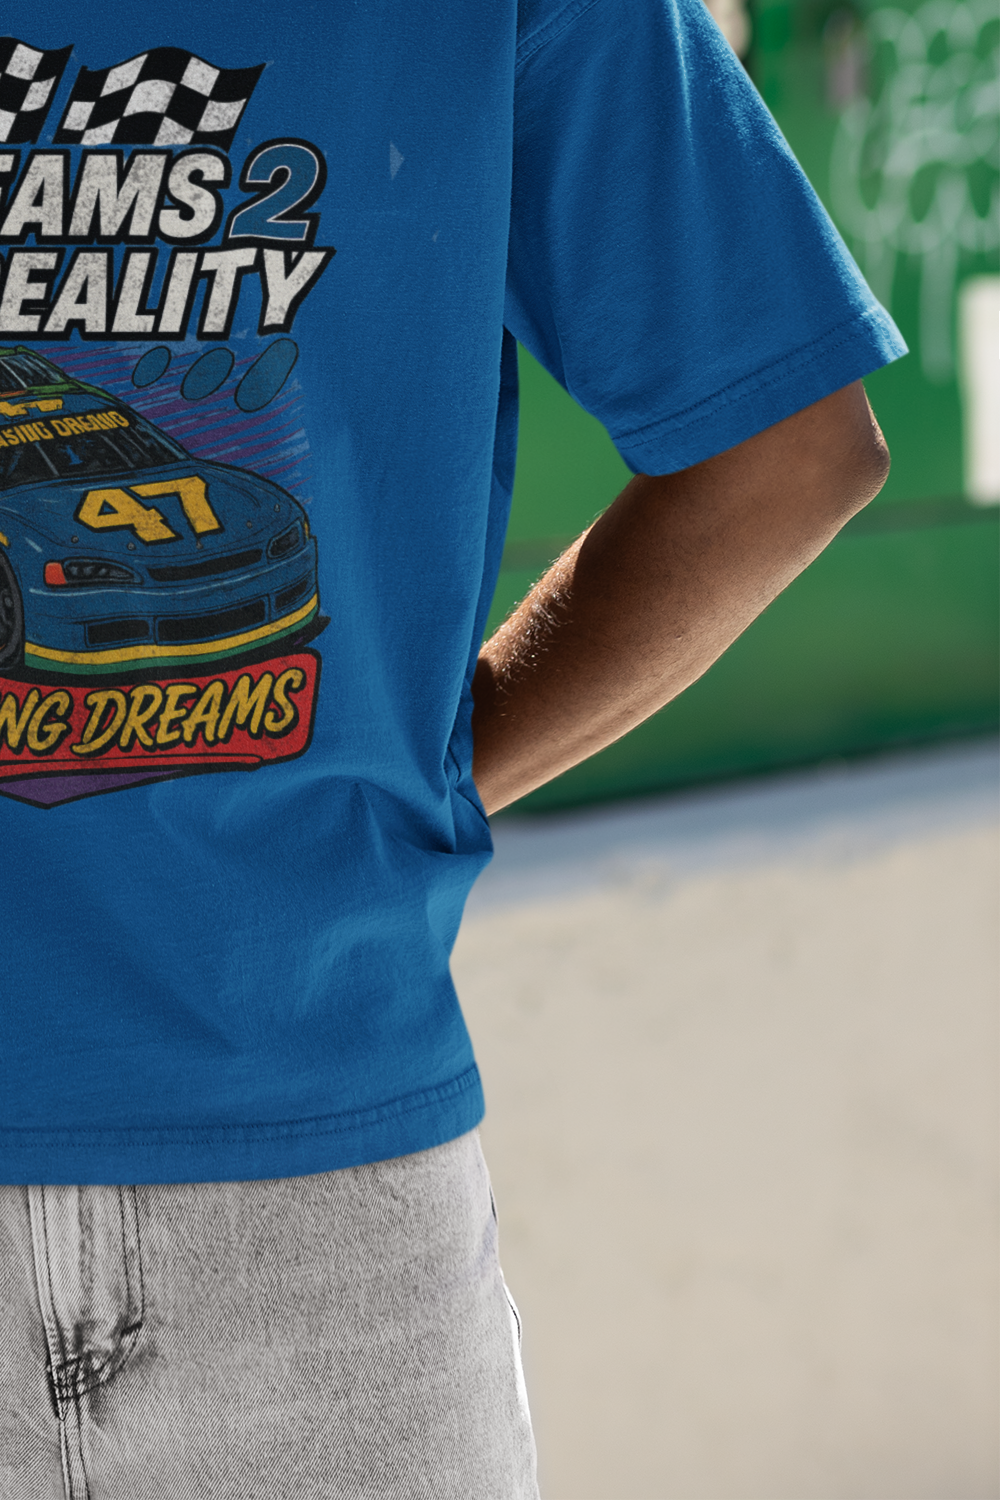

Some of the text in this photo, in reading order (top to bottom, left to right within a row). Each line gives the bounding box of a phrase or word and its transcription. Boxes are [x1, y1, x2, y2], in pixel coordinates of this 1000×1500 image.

[227, 142, 321, 242] 2
[76, 475, 223, 543] 47
[70, 667, 305, 754] DREAMS
